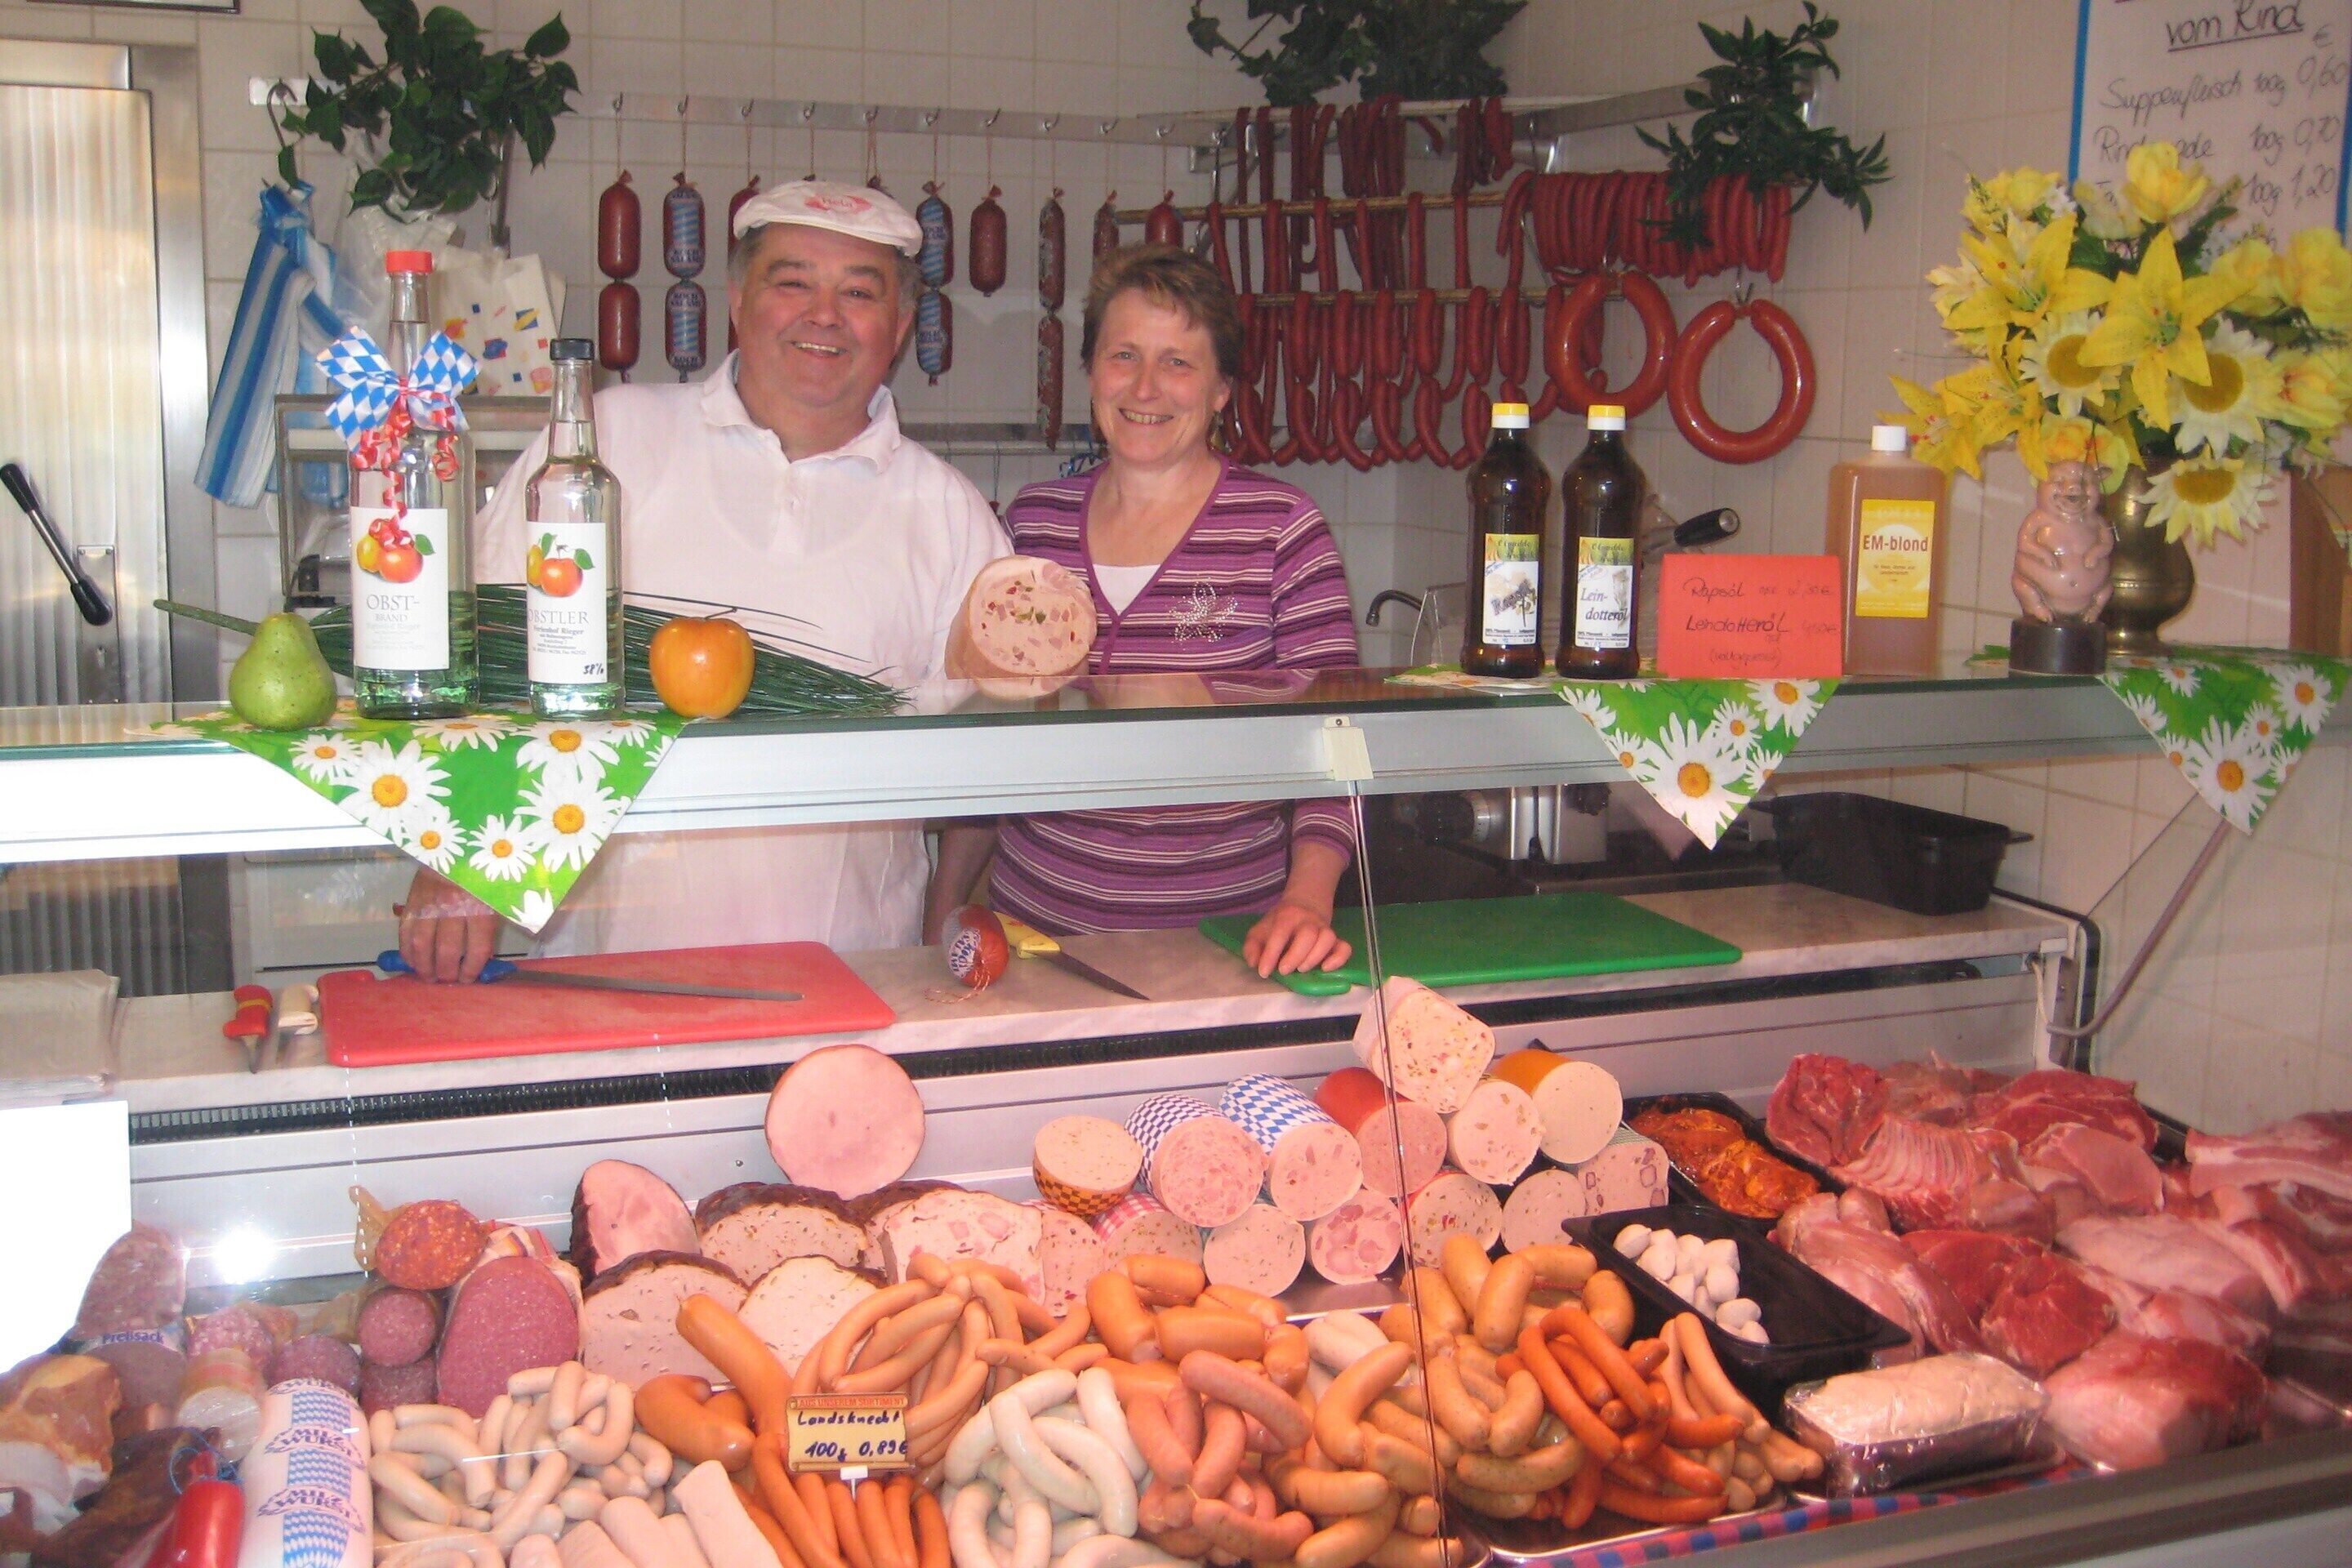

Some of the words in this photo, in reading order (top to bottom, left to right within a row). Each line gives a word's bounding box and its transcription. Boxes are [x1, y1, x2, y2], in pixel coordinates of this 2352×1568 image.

[2166, 16, 2221, 45] vom
[1863, 535, 1928, 552] EM-blond
[366, 594, 421, 611] OBST-
[1580, 588, 1608, 603] Lein-
[375, 613, 408, 622] BRAND
[528, 608, 590, 625] OBSTLER
[1585, 607, 1628, 621] dotteröl
[797, 1410, 901, 1426] Landsknecht
[804, 1441, 848, 1463] 100g
